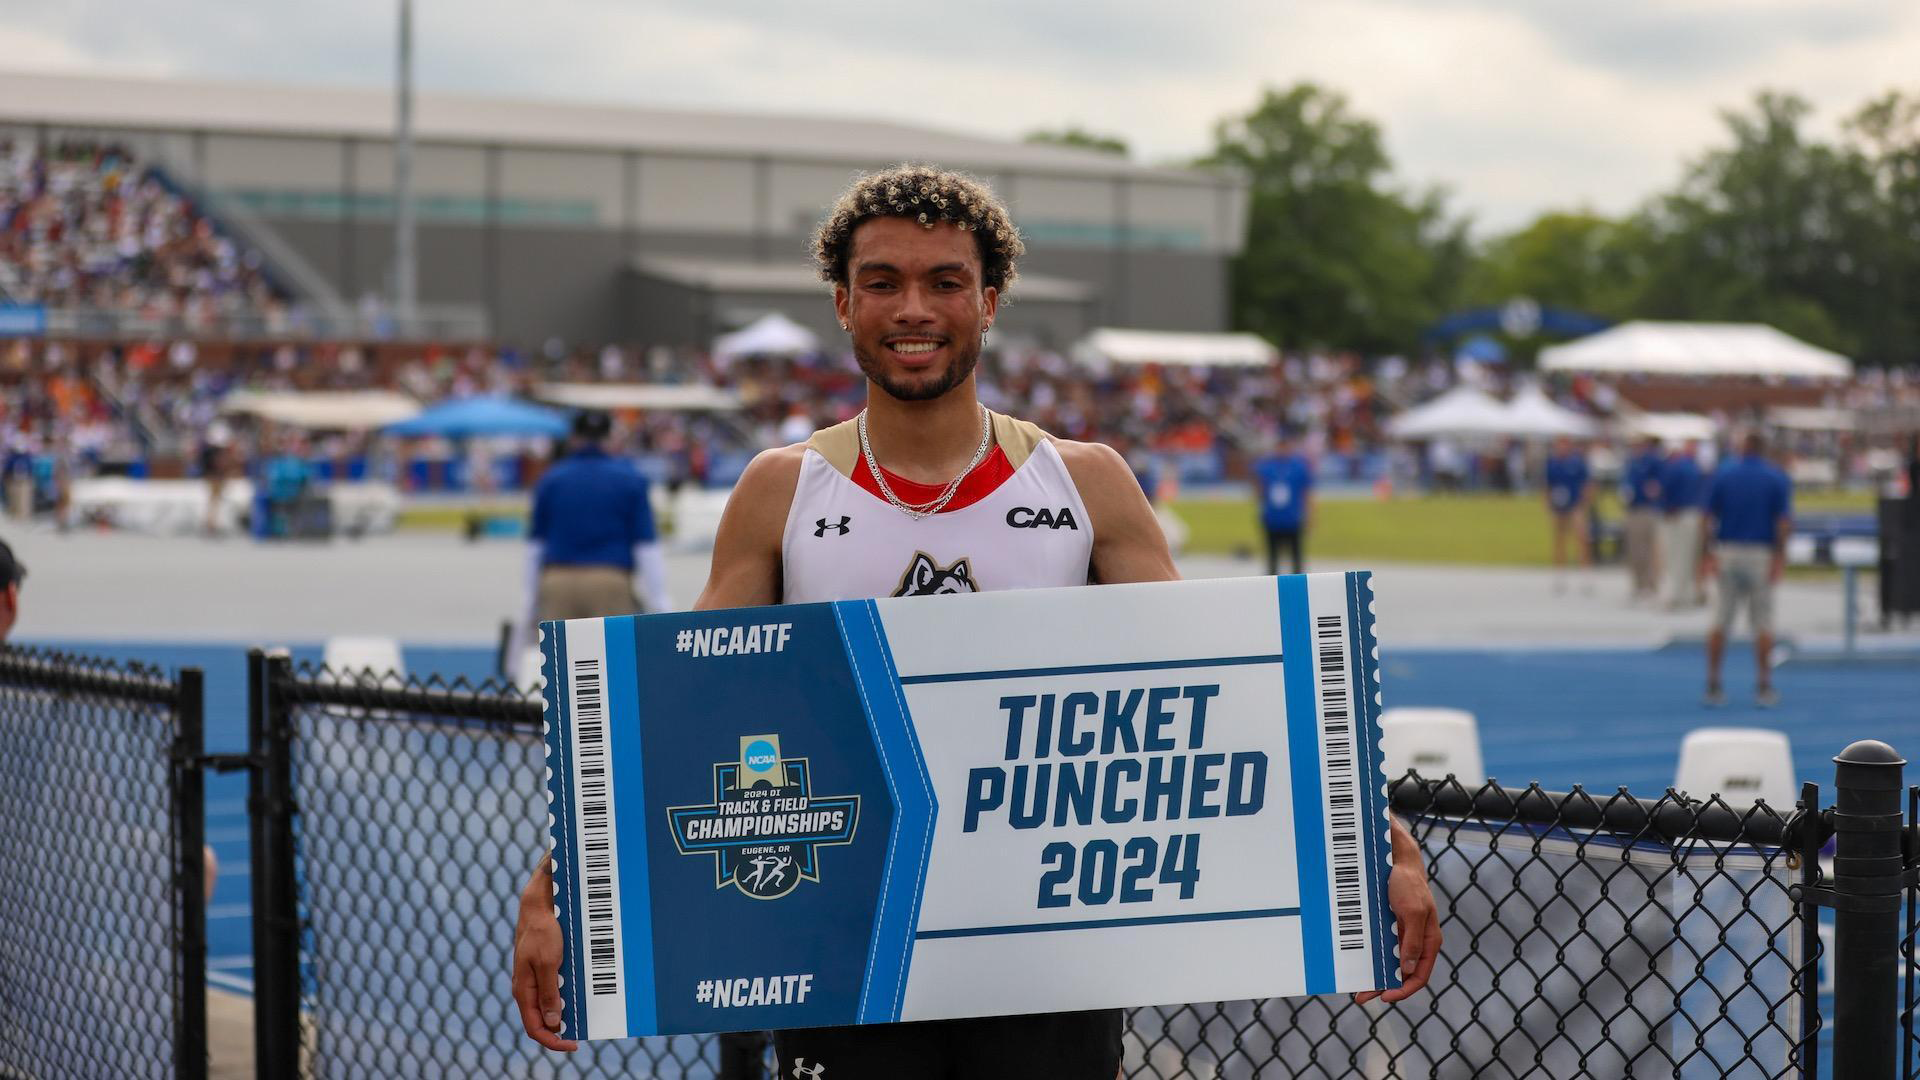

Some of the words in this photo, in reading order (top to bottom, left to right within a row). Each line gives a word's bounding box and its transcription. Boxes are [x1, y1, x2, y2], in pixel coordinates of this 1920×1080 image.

[1006, 506, 1078, 530] CAA
[675, 623, 792, 658] #NCAATF
[999, 684, 1220, 761] TICKET
[748, 755, 777, 765] NCAA
[718, 801, 758, 815] TRACK
[761, 800, 771, 813] &
[773, 797, 808, 812] FIELD
[743, 789, 768, 799] 2024
[769, 789, 781, 797] DI
[962, 751, 1268, 833] PUNCHED
[686, 811, 844, 840] CHAMPIONSHIPS
[741, 846, 776, 855] EUGENE,
[1037, 834, 1201, 909] 2024
[696, 975, 813, 1009] #NCAATF
